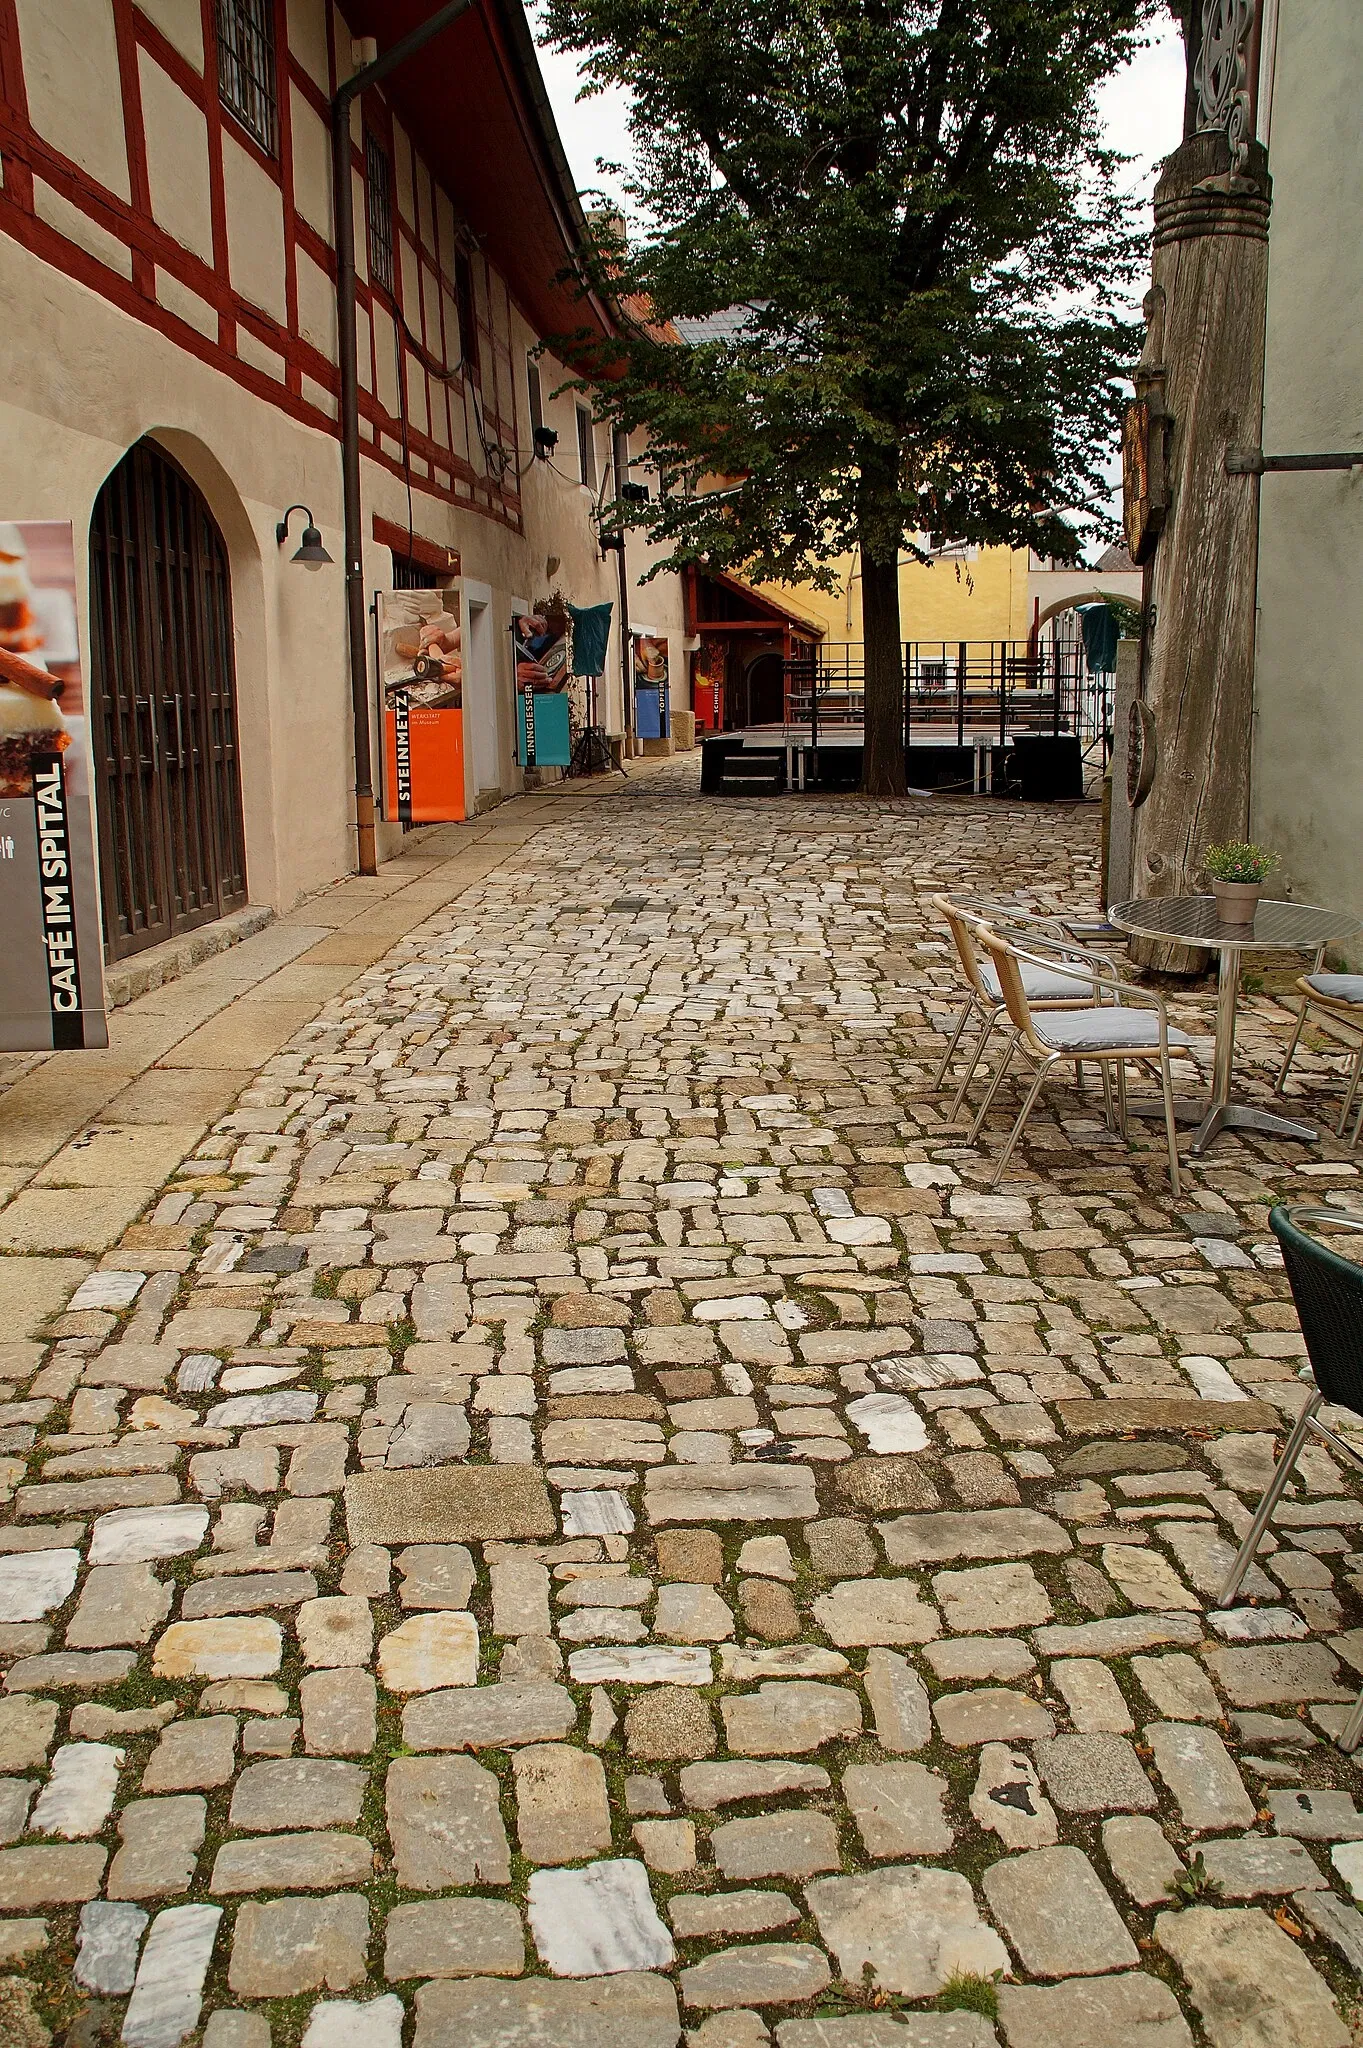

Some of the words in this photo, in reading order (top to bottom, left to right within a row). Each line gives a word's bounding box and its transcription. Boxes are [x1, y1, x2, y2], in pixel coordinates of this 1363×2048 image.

[395, 694, 411, 801] STEINMETZ
[0, 807, 11, 818] C
[35, 762, 67, 878] SPITAL
[45, 885, 71, 923] IM
[41, 931, 78, 1012] CAFÉ
